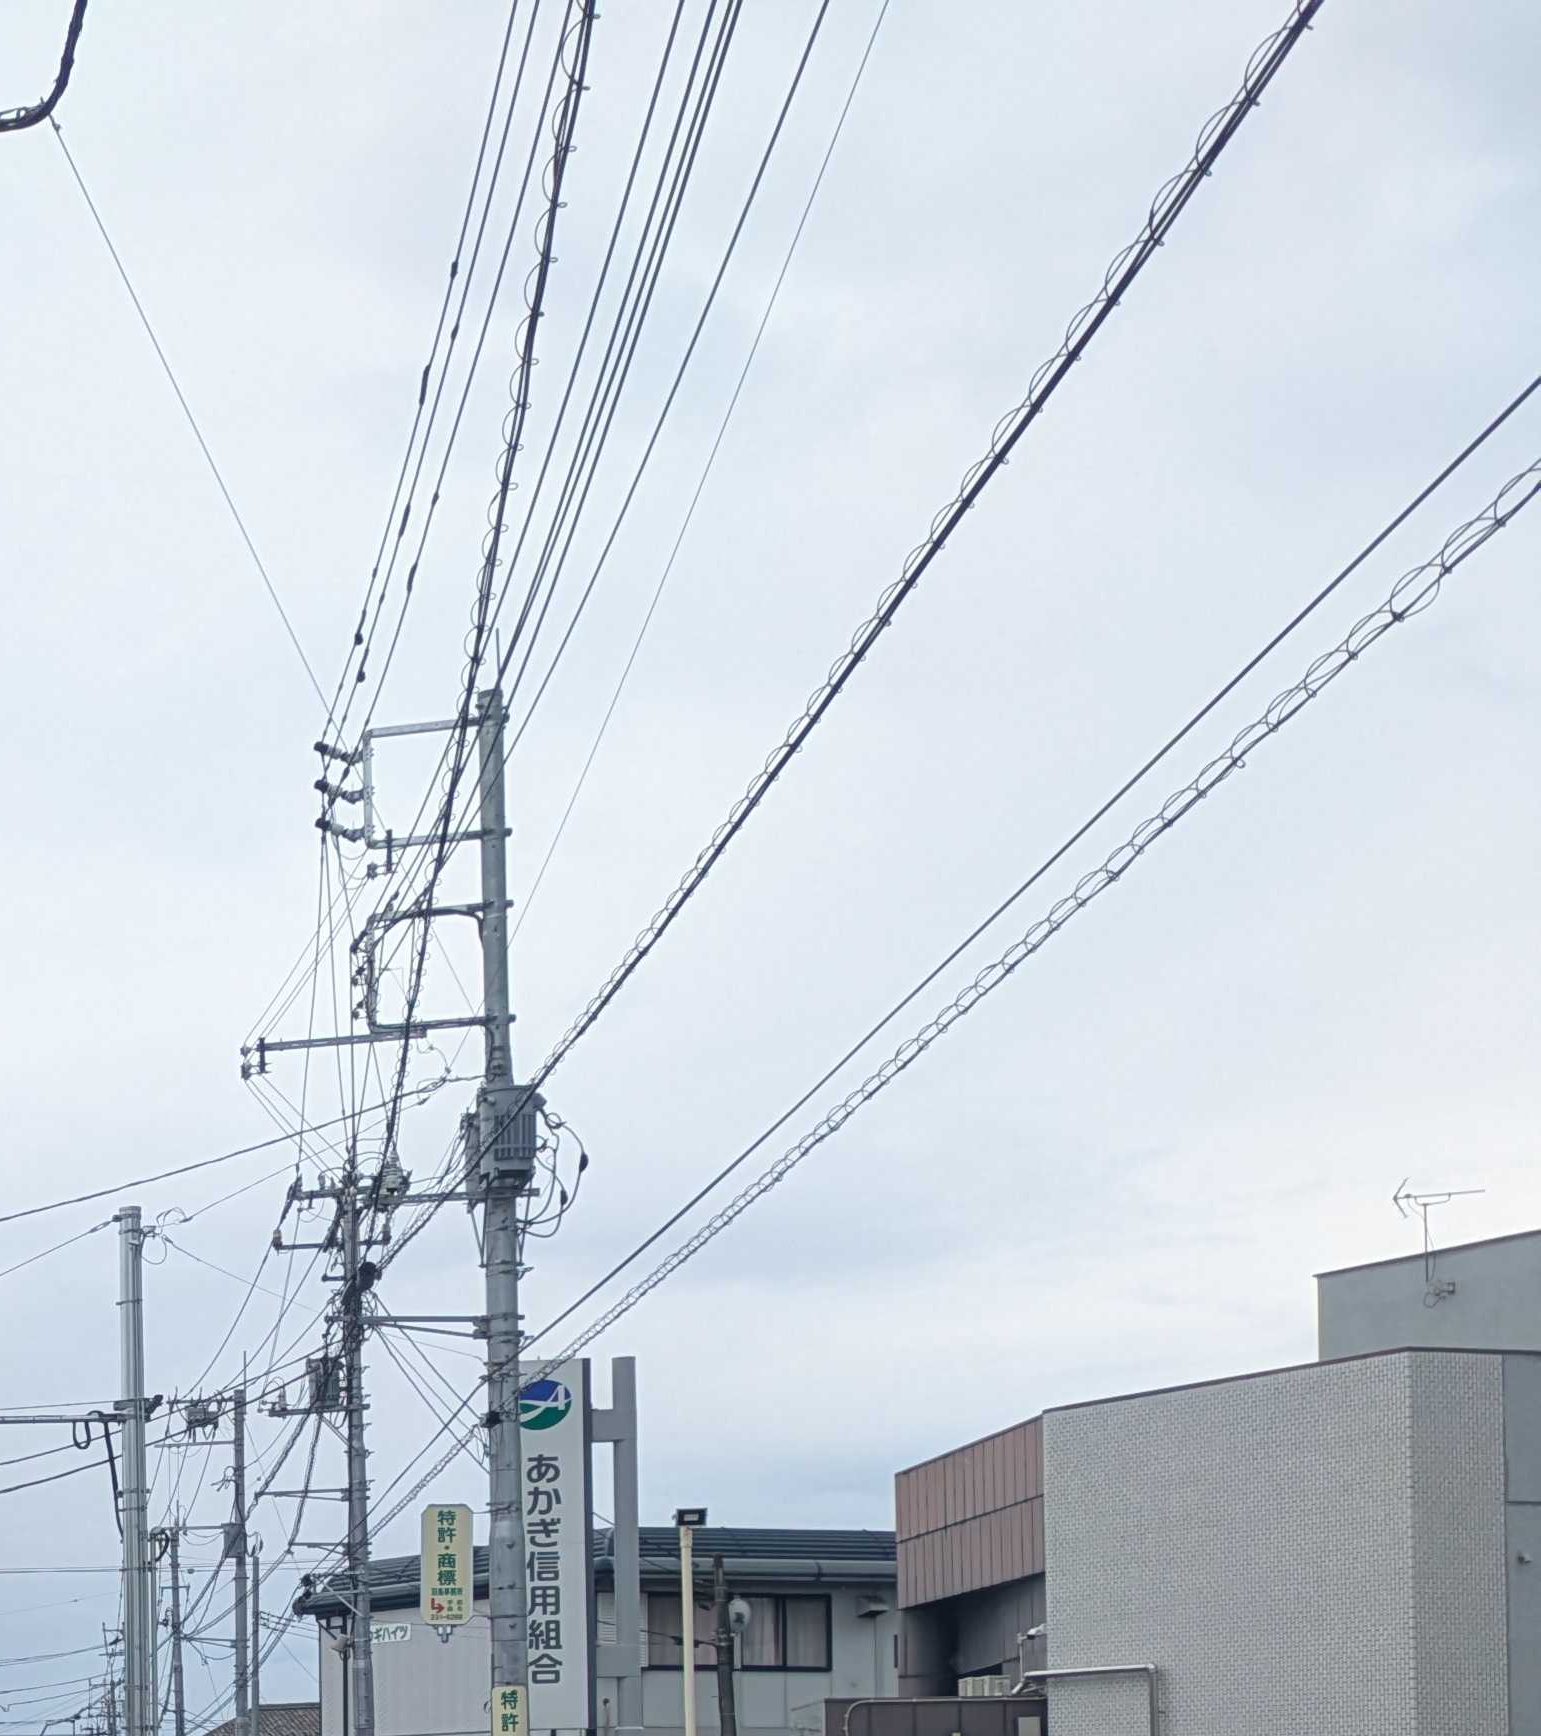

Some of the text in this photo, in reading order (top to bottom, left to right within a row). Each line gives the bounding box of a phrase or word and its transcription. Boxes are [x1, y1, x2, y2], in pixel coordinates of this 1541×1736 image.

[436, 1510, 457, 1586] 特許・商標
[526, 1453, 563, 1685] あかぎ信用組合
[371, 1625, 408, 1642] ギハイツ
